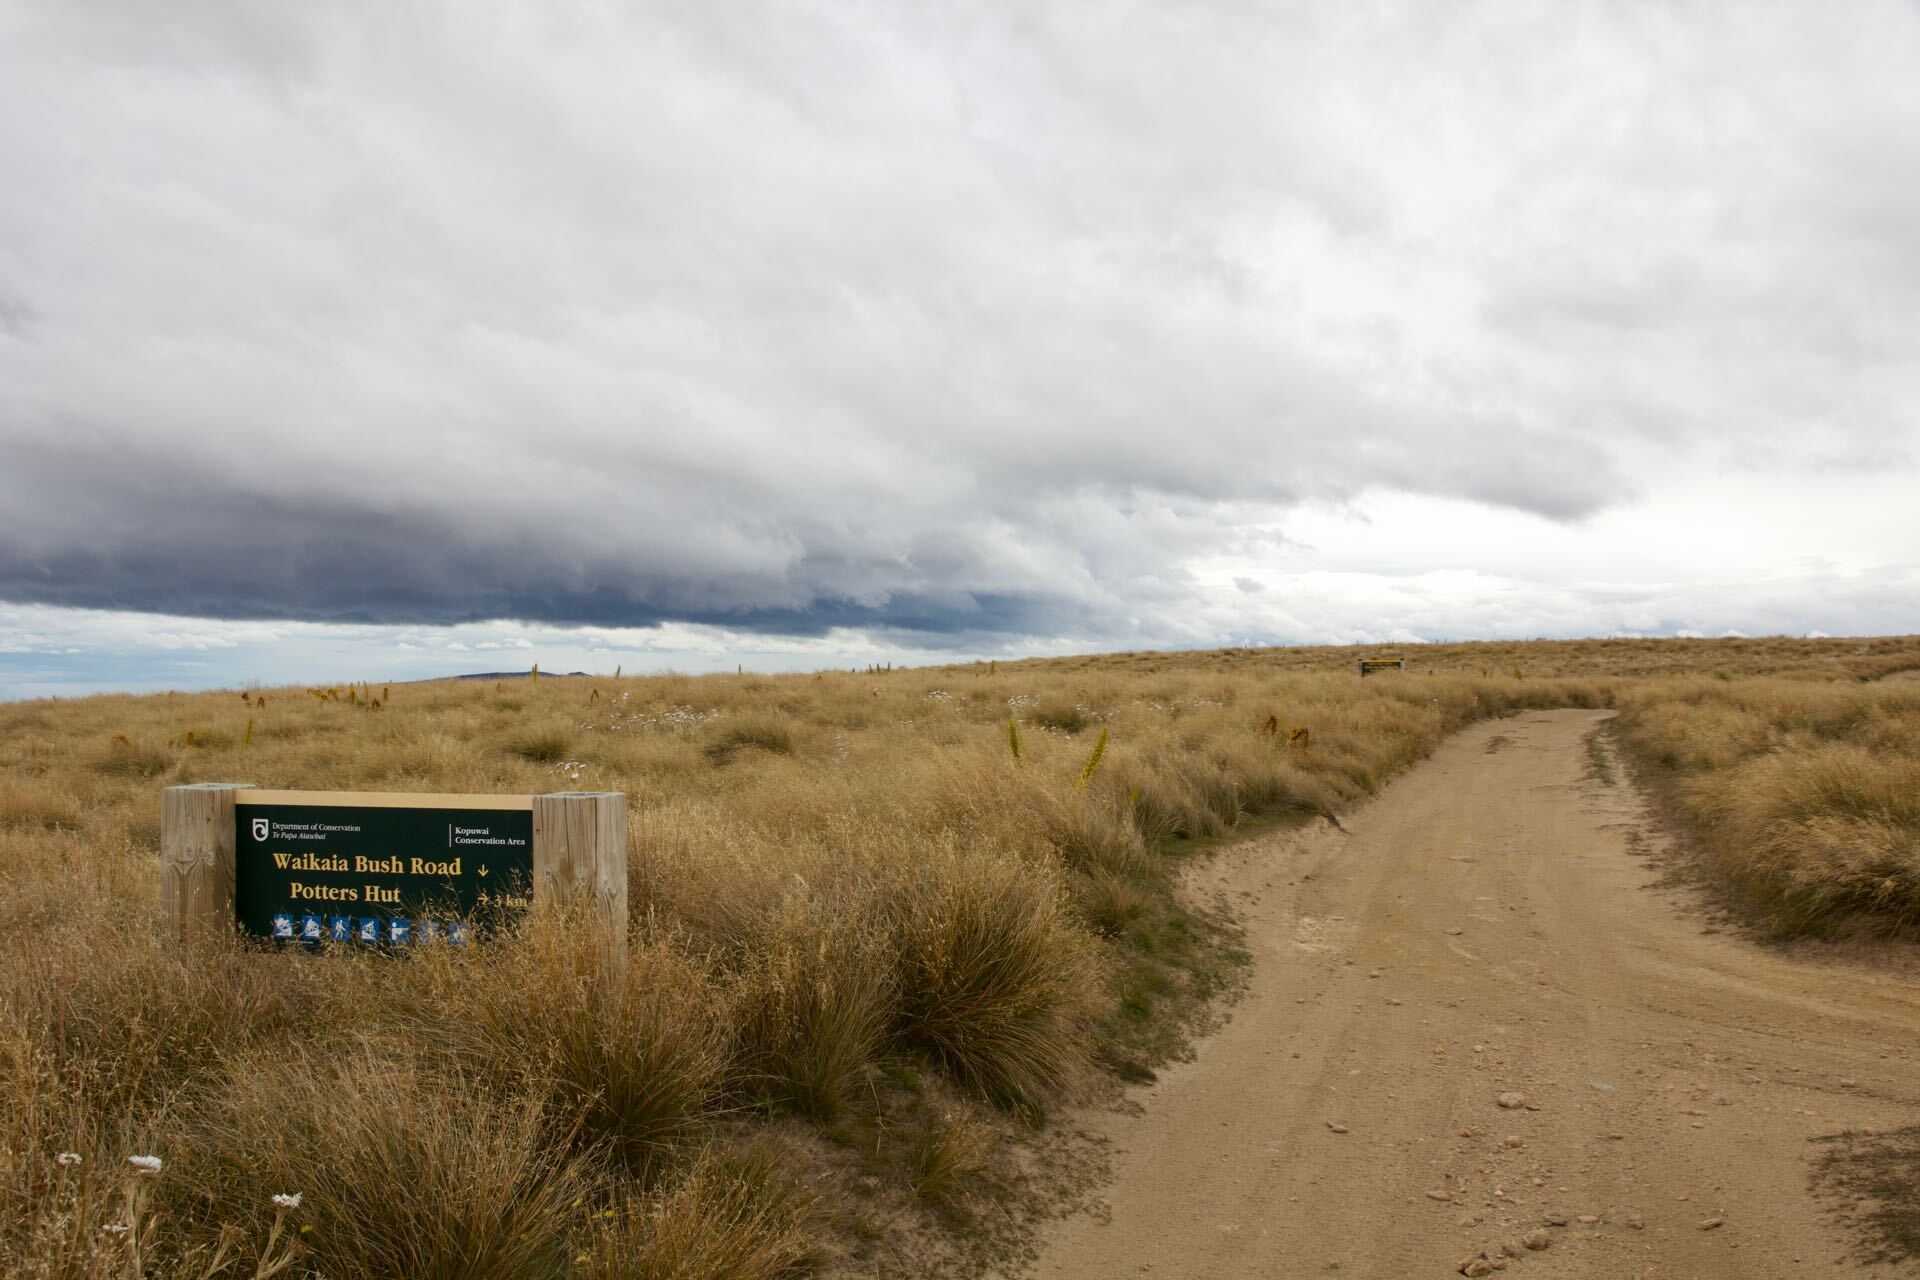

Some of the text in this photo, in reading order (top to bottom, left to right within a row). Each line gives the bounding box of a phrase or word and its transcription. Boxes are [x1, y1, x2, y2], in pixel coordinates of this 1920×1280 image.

[272, 822, 309, 831] Department
[319, 823, 361, 832] Conservation
[455, 827, 489, 836] Kopuwai
[272, 831, 327, 840] Te Papa Atawhai
[455, 836, 506, 845] Conservation
[272, 852, 463, 875] Waikaia Bush Road
[290, 882, 401, 903] Potters Hut
[506, 894, 528, 907] km
